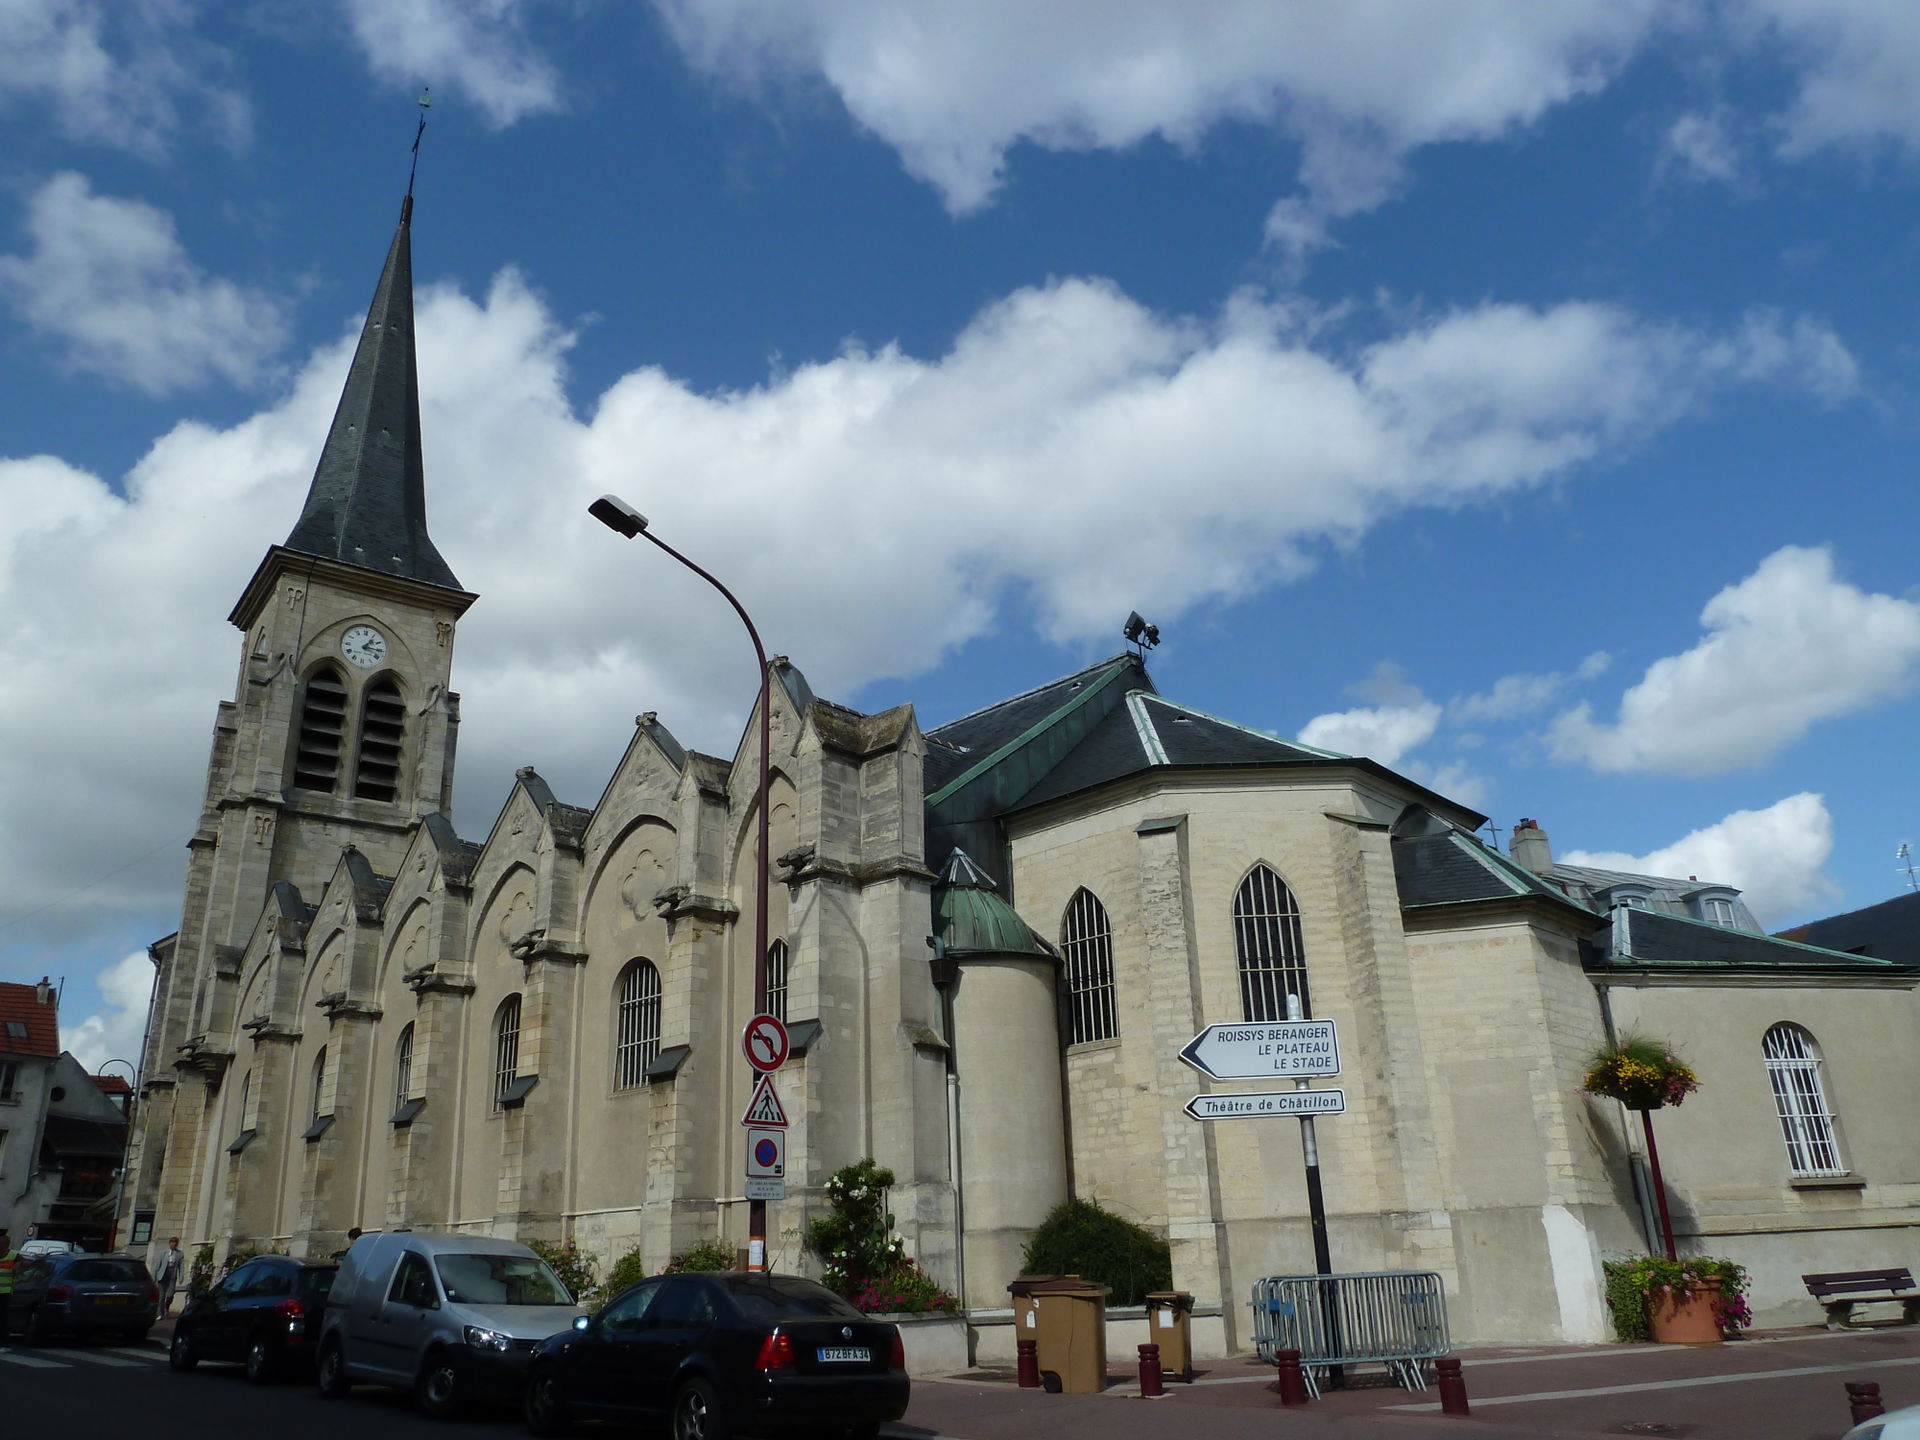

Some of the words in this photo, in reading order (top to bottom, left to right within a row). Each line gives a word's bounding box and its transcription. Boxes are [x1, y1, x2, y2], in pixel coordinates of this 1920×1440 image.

[1218, 1030, 1264, 1042] ROISSYS
[1268, 1027, 1328, 1040] BERANGER
[1258, 1044, 1271, 1056] LE
[1277, 1042, 1329, 1054] PLATEAU
[1274, 1058, 1286, 1069] LE
[1293, 1057, 1331, 1068] STADE
[1206, 1101, 1252, 1112] Théâtre
[1259, 1099, 1273, 1110] de
[1279, 1096, 1337, 1109] Châtillon
